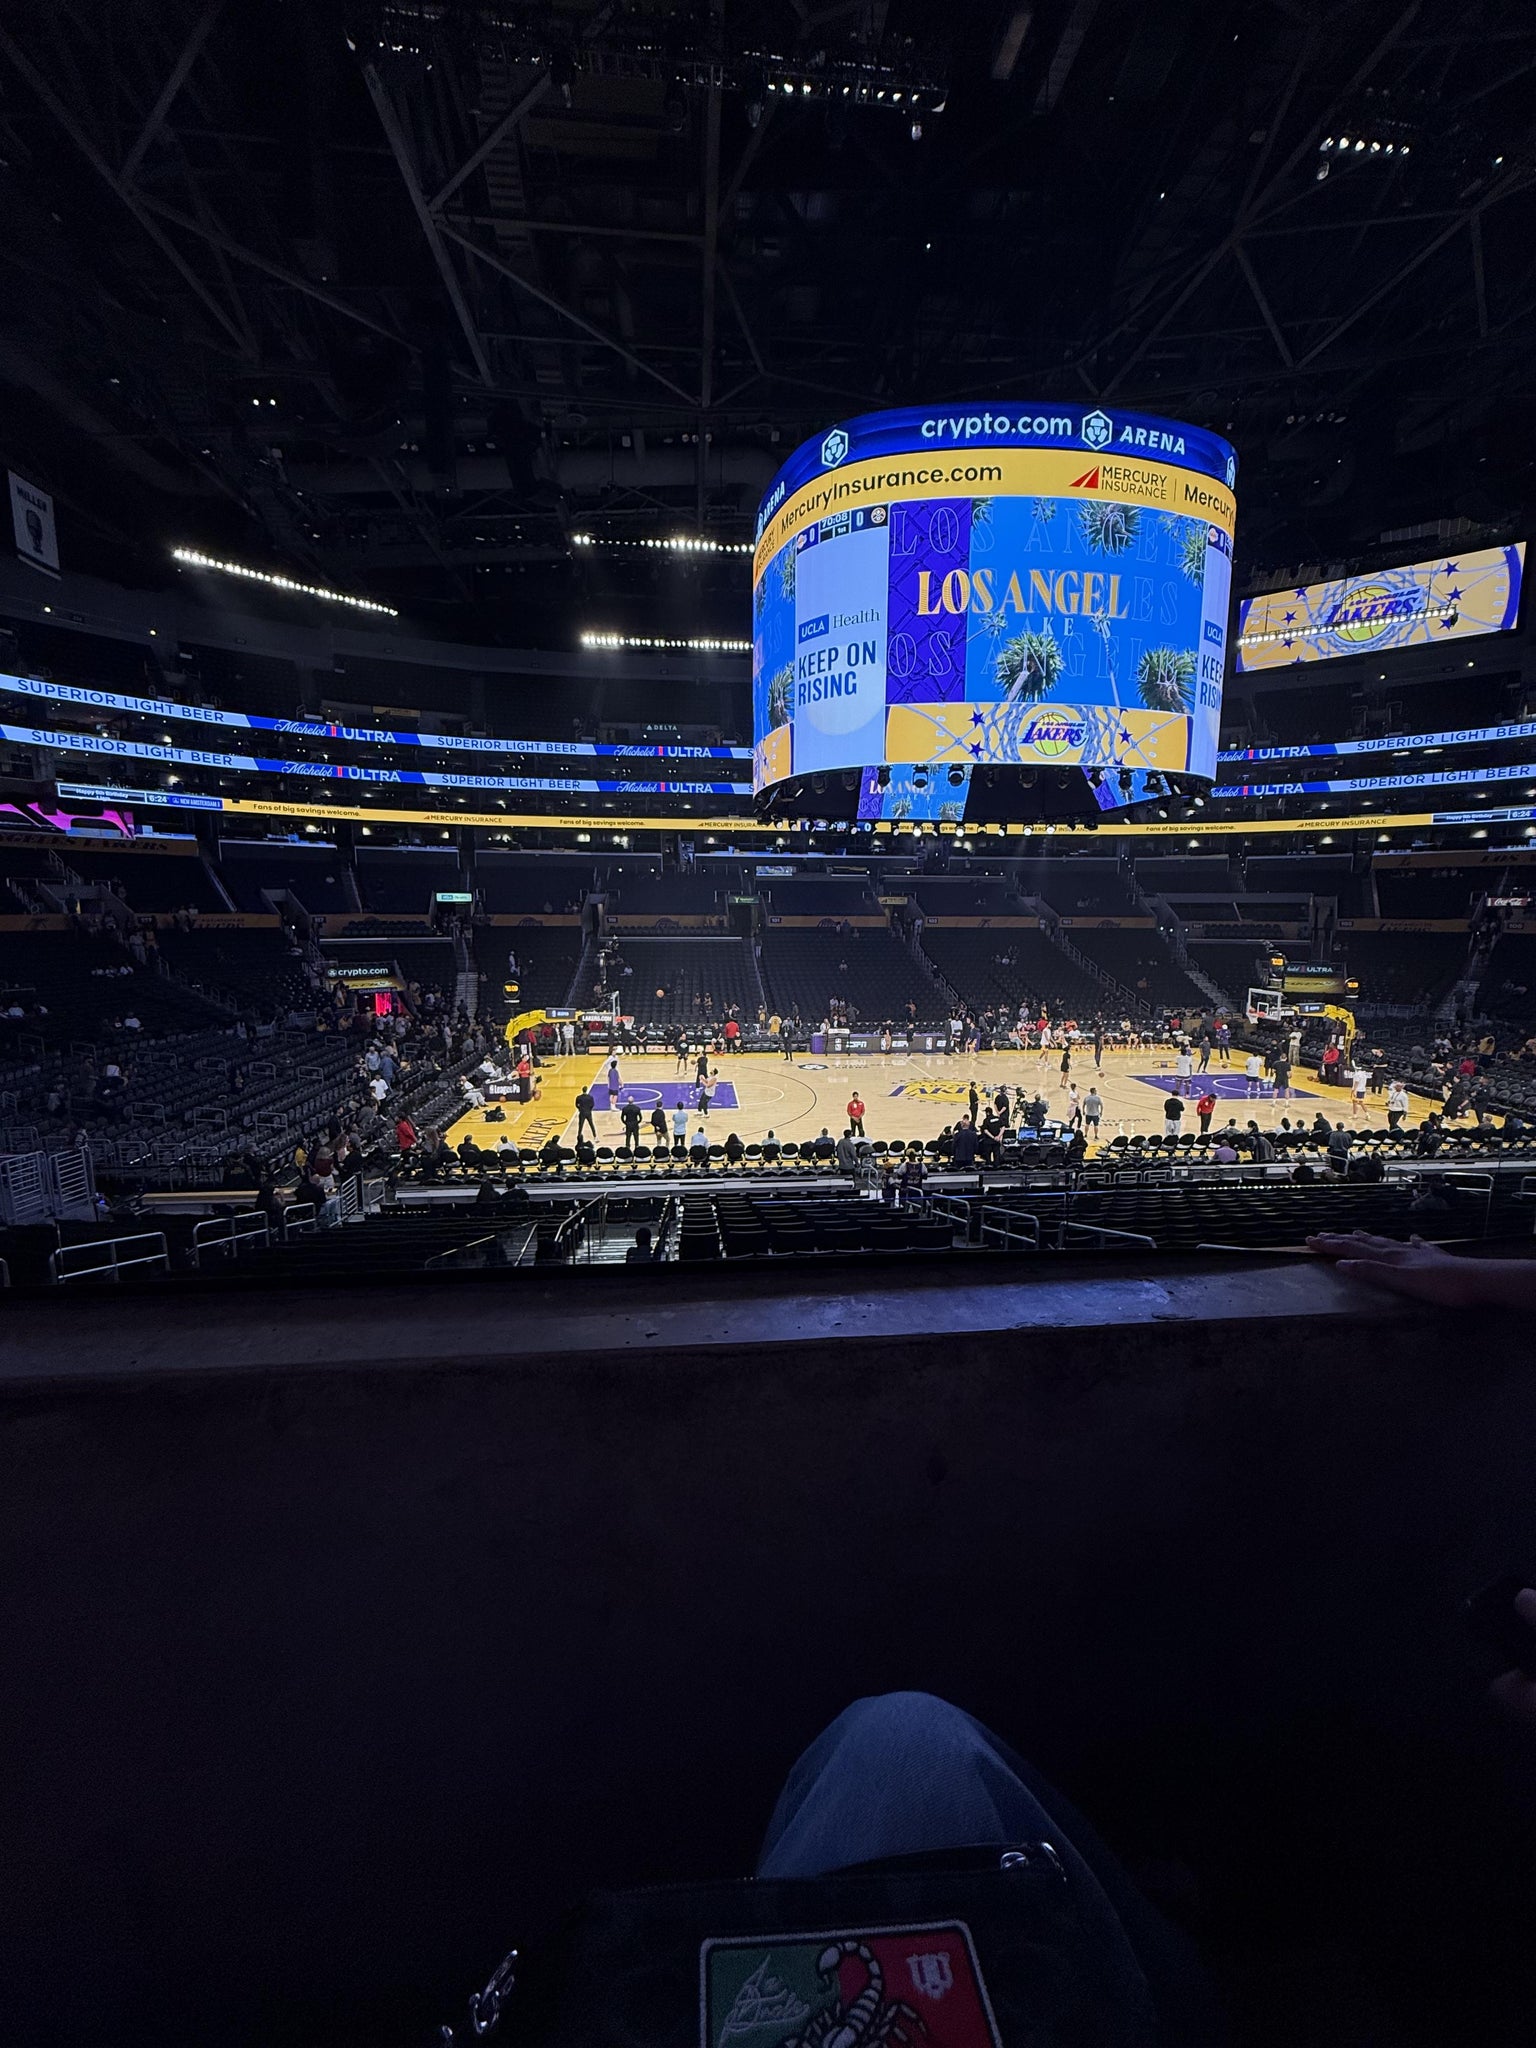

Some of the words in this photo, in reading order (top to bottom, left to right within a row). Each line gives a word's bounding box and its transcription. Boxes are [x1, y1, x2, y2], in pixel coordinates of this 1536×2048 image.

[921, 412, 1072, 439] crypto.com
[1119, 425, 1186, 455] ARENA
[1102, 465, 1167, 487] MERCURY
[780, 465, 1002, 534] MercuryInsurance.com
[1101, 479, 1167, 500] INSURANCE
[856, 512, 864, 527] 0
[809, 527, 815, 542] 0
[916, 569, 993, 616] LOS
[1001, 569, 1130, 620] ANGEL
[1323, 596, 1419, 627] LAKERS
[801, 620, 825, 638] UCLA
[833, 608, 880, 628] Health
[798, 646, 839, 680] KEEP
[847, 640, 876, 667] ON
[798, 670, 857, 706] RISING
[18, 679, 117, 706] SUPERIOR
[124, 696, 175, 715] LIGHT
[182, 707, 224, 722] BEER
[273, 719, 327, 736] Michelob
[343, 728, 396, 743] ULTRA
[1021, 721, 1088, 747] LAKERS
[1357, 735, 1434, 751] SUPERIOR
[1441, 729, 1489, 743] LIGHT
[32, 731, 127, 753] SUPERIOR
[135, 744, 185, 760] LIGHT
[192, 752, 233, 766] BEER
[437, 737, 501, 750] SUPERIOR
[506, 742, 541, 751] LIGHT
[546, 744, 577, 753] BEER
[614, 745, 655, 757] Michelob
[668, 747, 712, 758] ULTRA
[1259, 746, 1311, 759] ULTRA
[281, 760, 333, 777] Michelob
[348, 767, 401, 782] ULTRA
[442, 774, 505, 787] SUPERIOR
[509, 778, 544, 788] LIGHT
[549, 780, 581, 789] BEER
[1350, 775, 1425, 789] SUPERIOR
[1432, 770, 1479, 783] LIGHT
[1486, 766, 1530, 779] BEER
[616, 781, 658, 793] Michelob
[669, 783, 714, 793] ULTRA
[1253, 784, 1305, 795] ULTRA
[149, 795, 168, 803] 6:24
[253, 803, 272, 811] Fans
[274, 804, 281, 812] of
[282, 805, 295, 815] big
[296, 806, 325, 817] savings
[326, 808, 361, 817] welcome.
[431, 814, 463, 822] MERCURY
[1304, 820, 1341, 828] MERCURY
[1341, 818, 1387, 826] INSURANCE
[338, 967, 389, 977] crypto.com
